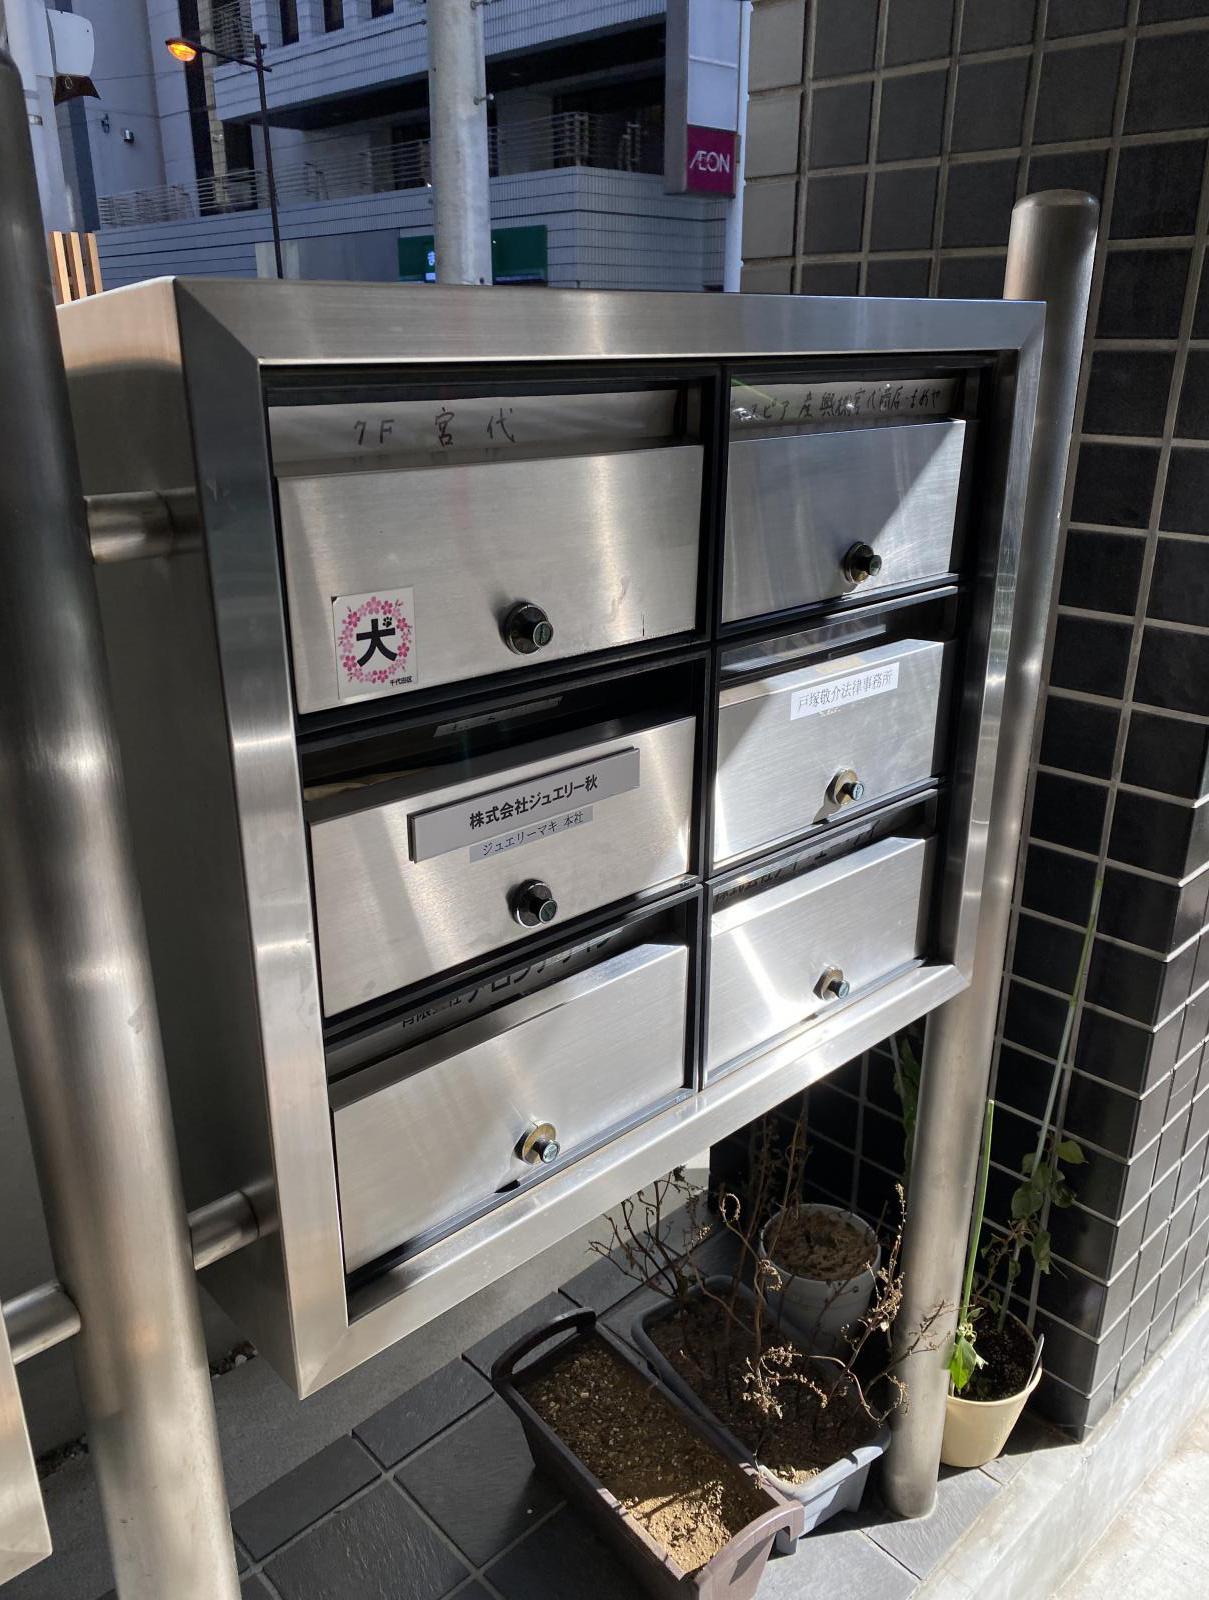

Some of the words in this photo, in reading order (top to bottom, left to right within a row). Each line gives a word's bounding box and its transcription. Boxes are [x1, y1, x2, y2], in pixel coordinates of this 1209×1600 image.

[354, 420, 394, 446] 7F
[356, 618, 397, 667] 犬
[469, 774, 598, 830] 株式会社ジュエリー秋
[563, 811, 584, 828] 本社
